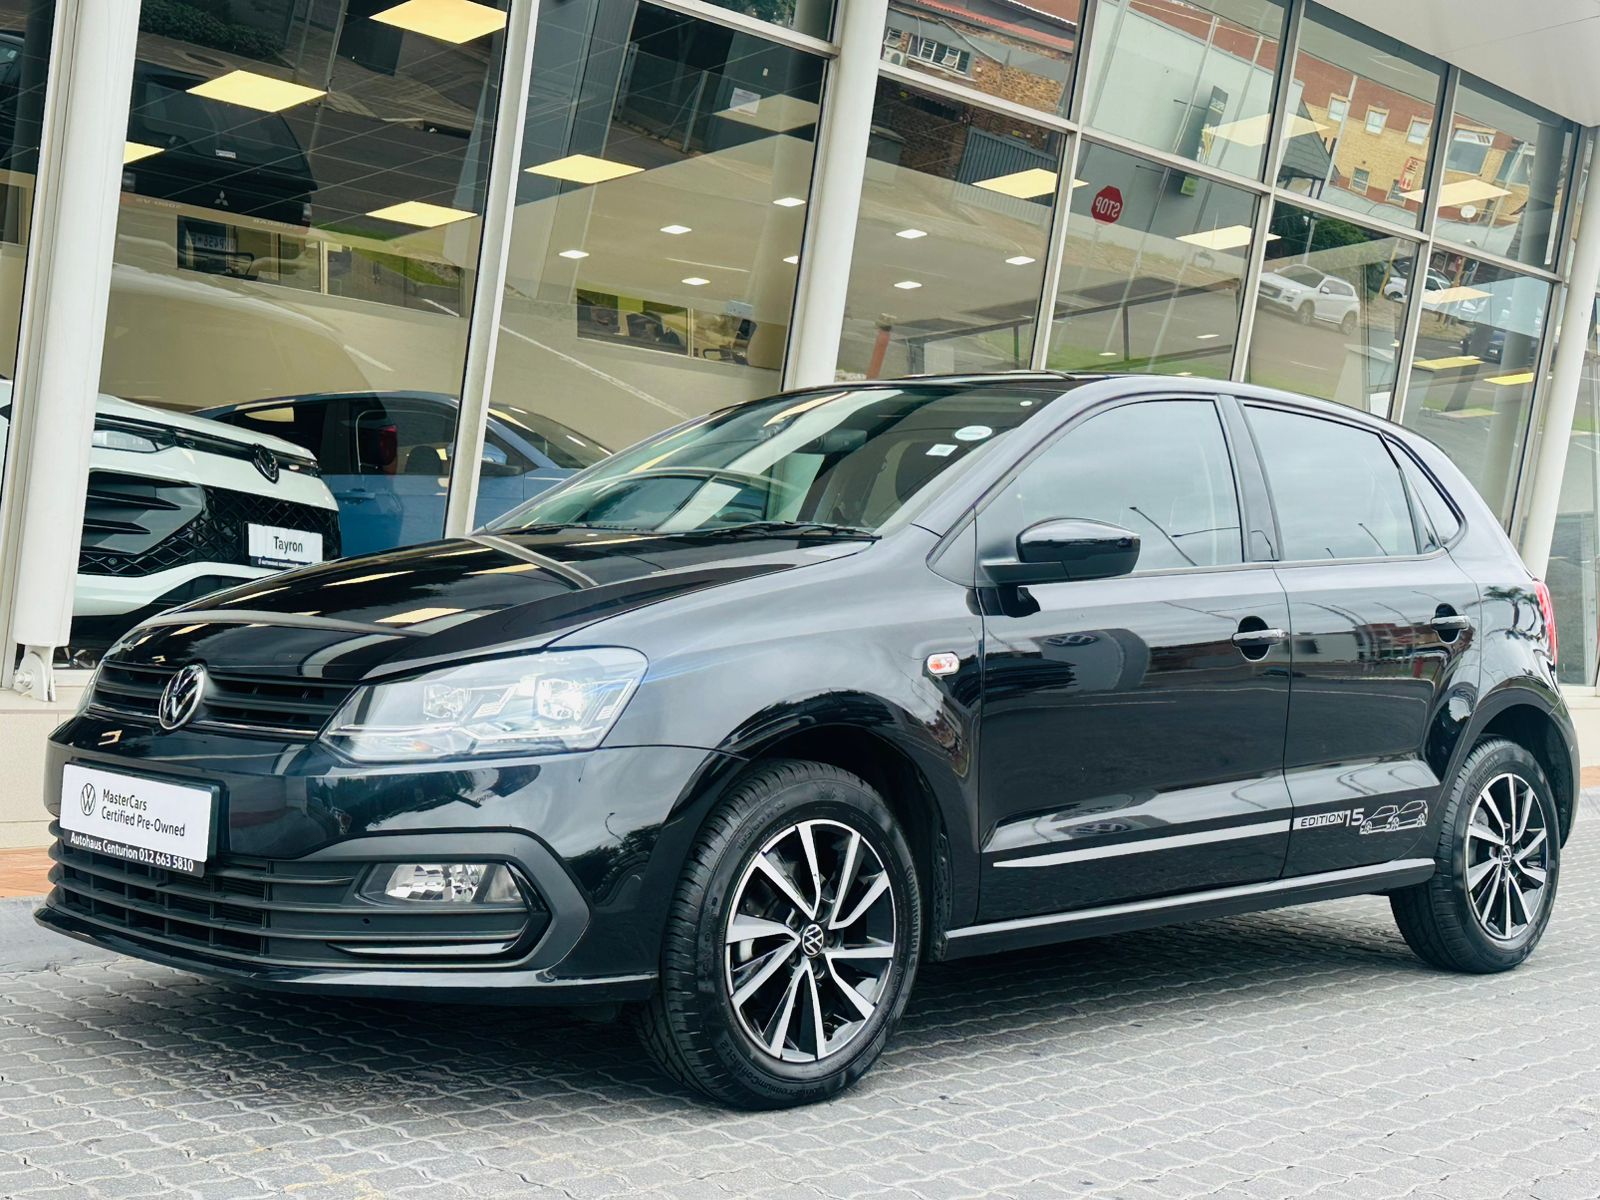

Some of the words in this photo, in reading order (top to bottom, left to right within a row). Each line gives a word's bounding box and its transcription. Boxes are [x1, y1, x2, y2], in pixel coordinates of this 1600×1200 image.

[273, 536, 303, 554] Tayron
[102, 788, 148, 811] MasterCars
[101, 806, 135, 826] Certified
[136, 814, 186, 837] Pre-Owned
[1300, 812, 1345, 827] EDITION
[70, 832, 102, 850] Autohaus
[102, 840, 138, 859] Centurion
[138, 848, 154, 863] 012
[155, 852, 171, 867] 663
[172, 856, 194, 872] 5810
